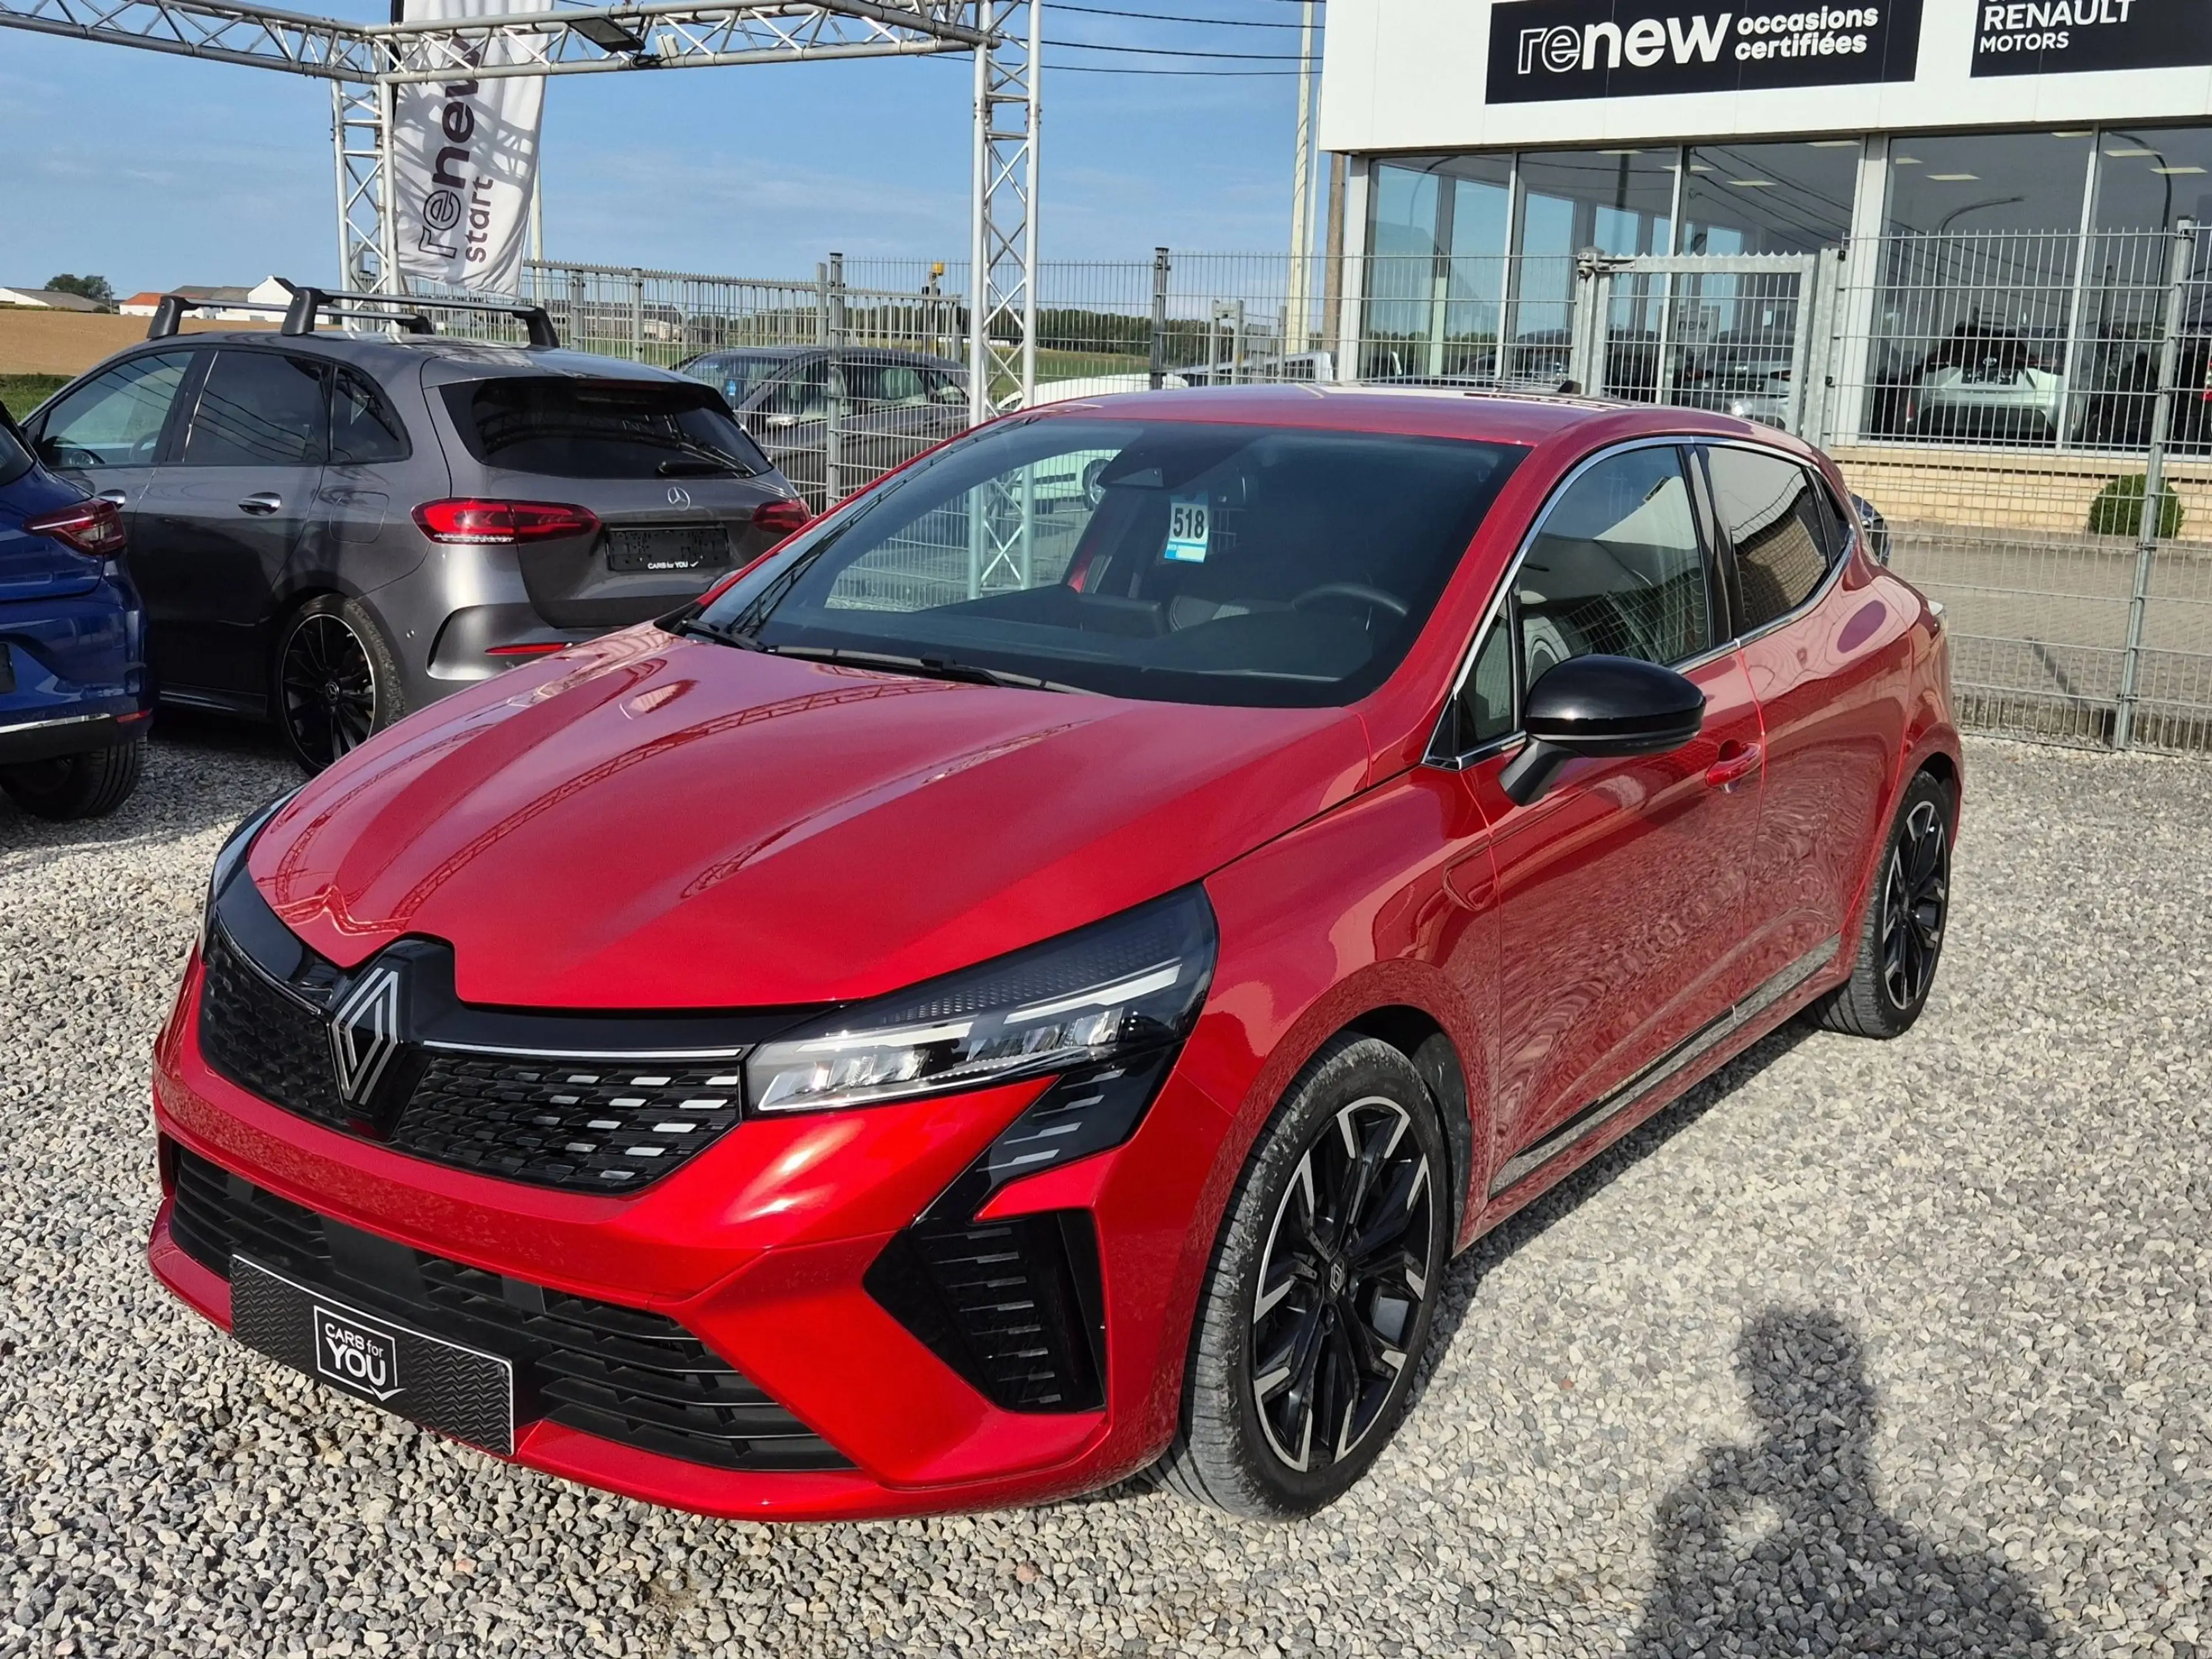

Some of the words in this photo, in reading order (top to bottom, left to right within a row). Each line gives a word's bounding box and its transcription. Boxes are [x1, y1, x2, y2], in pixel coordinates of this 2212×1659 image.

[1737, 5, 1878, 36] occasions
[1983, 0, 2136, 31] RENAULT
[1517, 13, 1732, 75] renew
[1734, 32, 1868, 60] certifiées
[1979, 31, 2070, 54] MOTORS
[465, 177, 494, 263] start
[1173, 507, 1205, 539] 518
[324, 1322, 365, 1350] CARS
[366, 1339, 384, 1358] for
[325, 1336, 387, 1387] YOU
